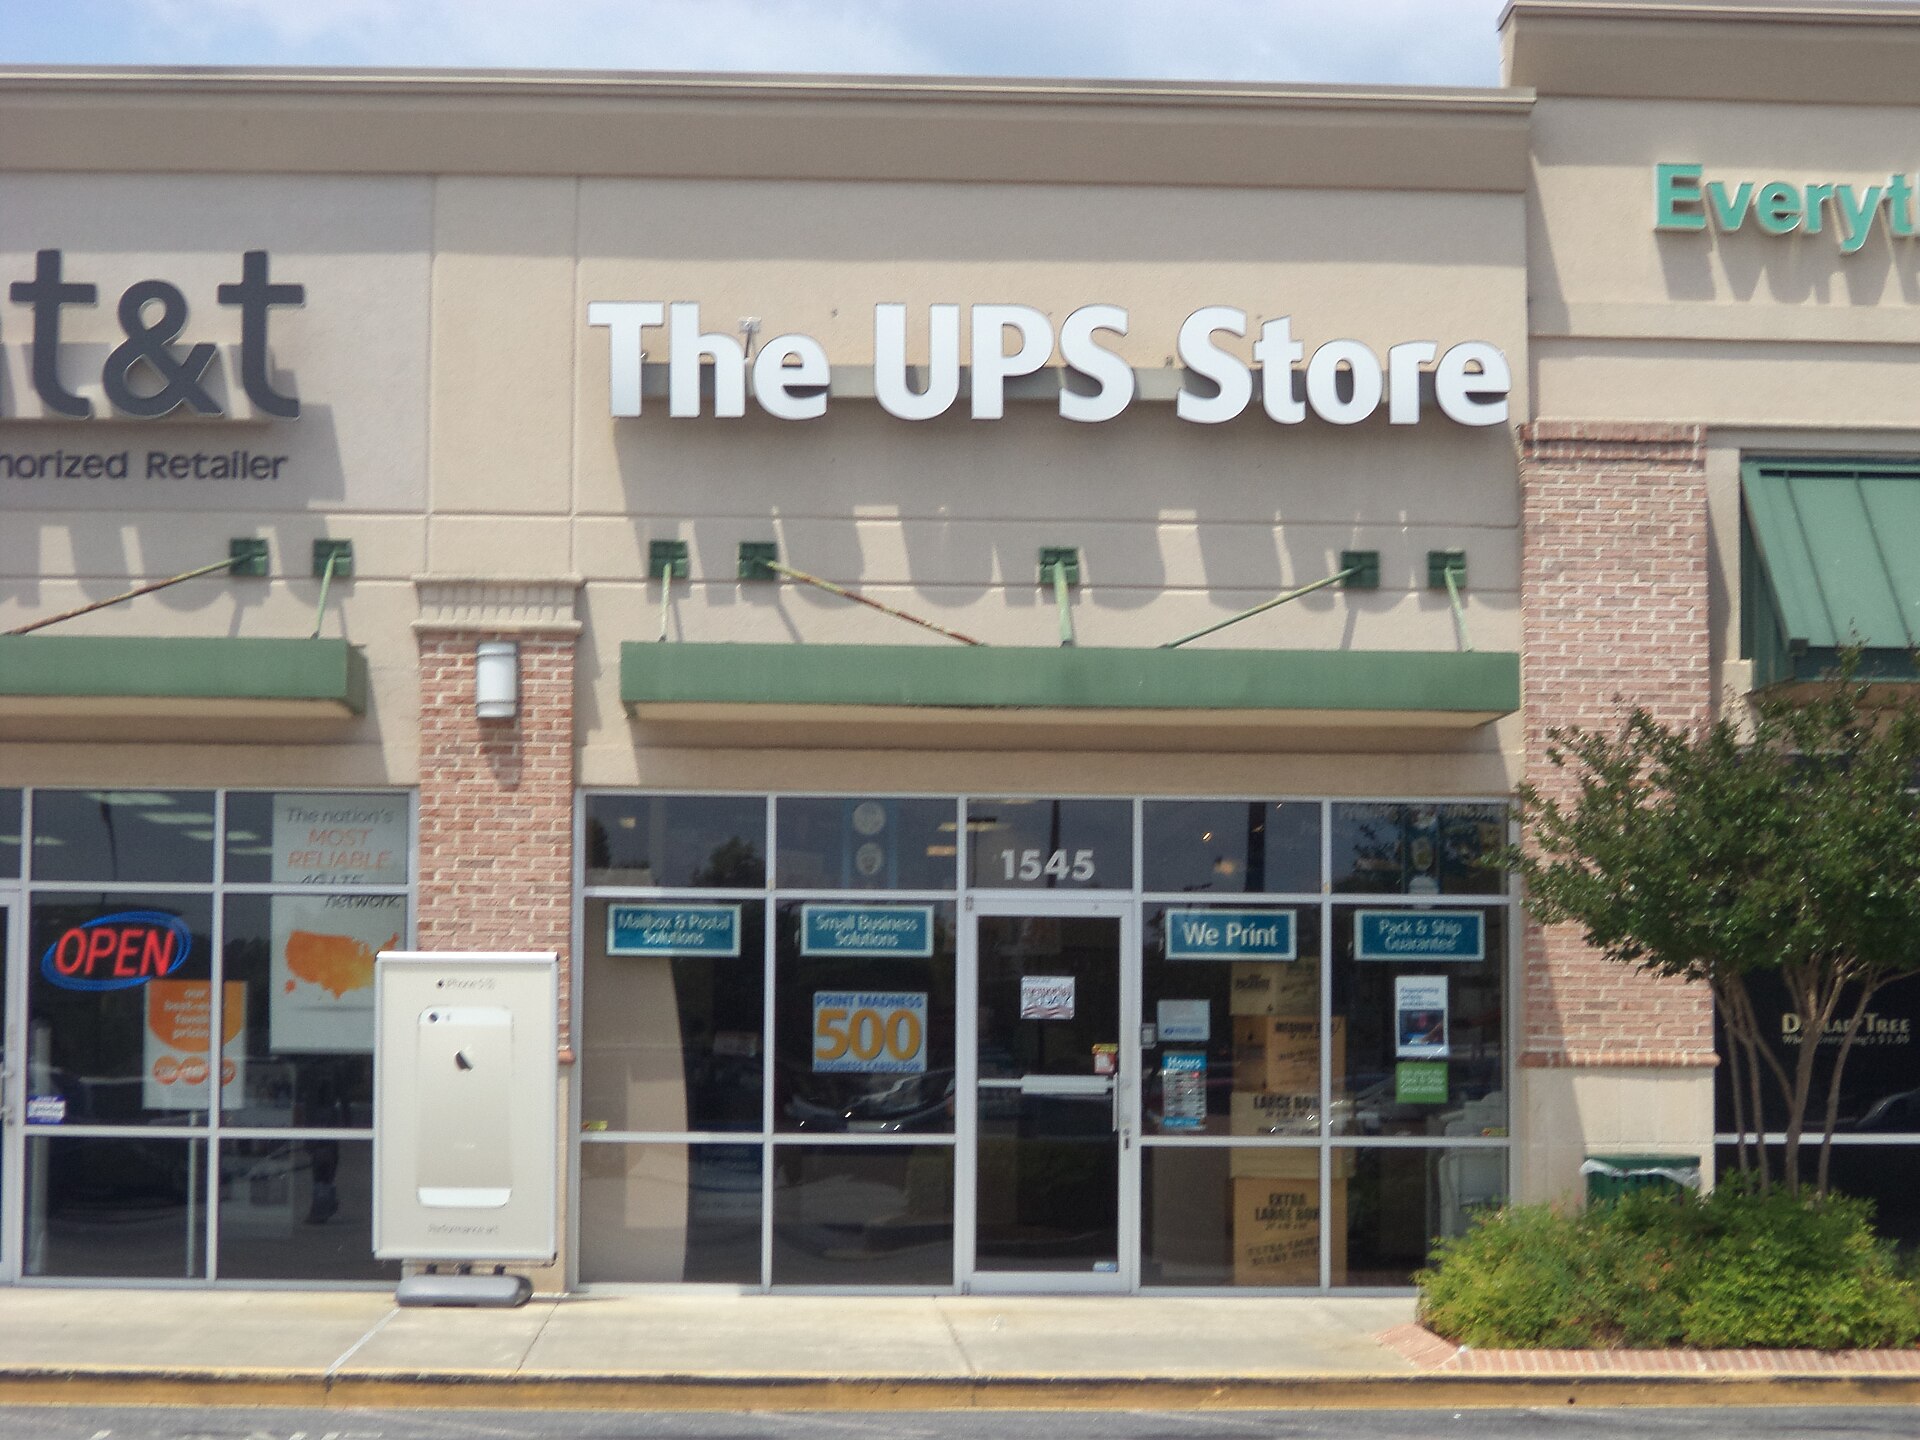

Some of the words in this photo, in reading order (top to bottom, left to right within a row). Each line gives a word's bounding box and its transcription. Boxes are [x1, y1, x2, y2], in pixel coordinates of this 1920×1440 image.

[587, 302, 832, 419] The
[874, 303, 1135, 421] UPS
[1177, 305, 1512, 425] Store
[146, 450, 288, 480] Retailer
[307, 828, 373, 847] MOST
[287, 850, 393, 870] RELIABLE
[1000, 848, 1096, 881] 1545
[815, 913, 855, 931] Small
[858, 914, 918, 931] Business
[1379, 919, 1412, 936] Pack
[1415, 919, 1428, 936] &
[1431, 919, 1462, 938] Ship
[641, 929, 705, 946] Solutions
[834, 930, 899, 947] Solutions
[1182, 922, 1220, 947] We
[1226, 922, 1279, 947] Print
[54, 928, 175, 976] OPEN
[815, 1008, 922, 1061] 500
